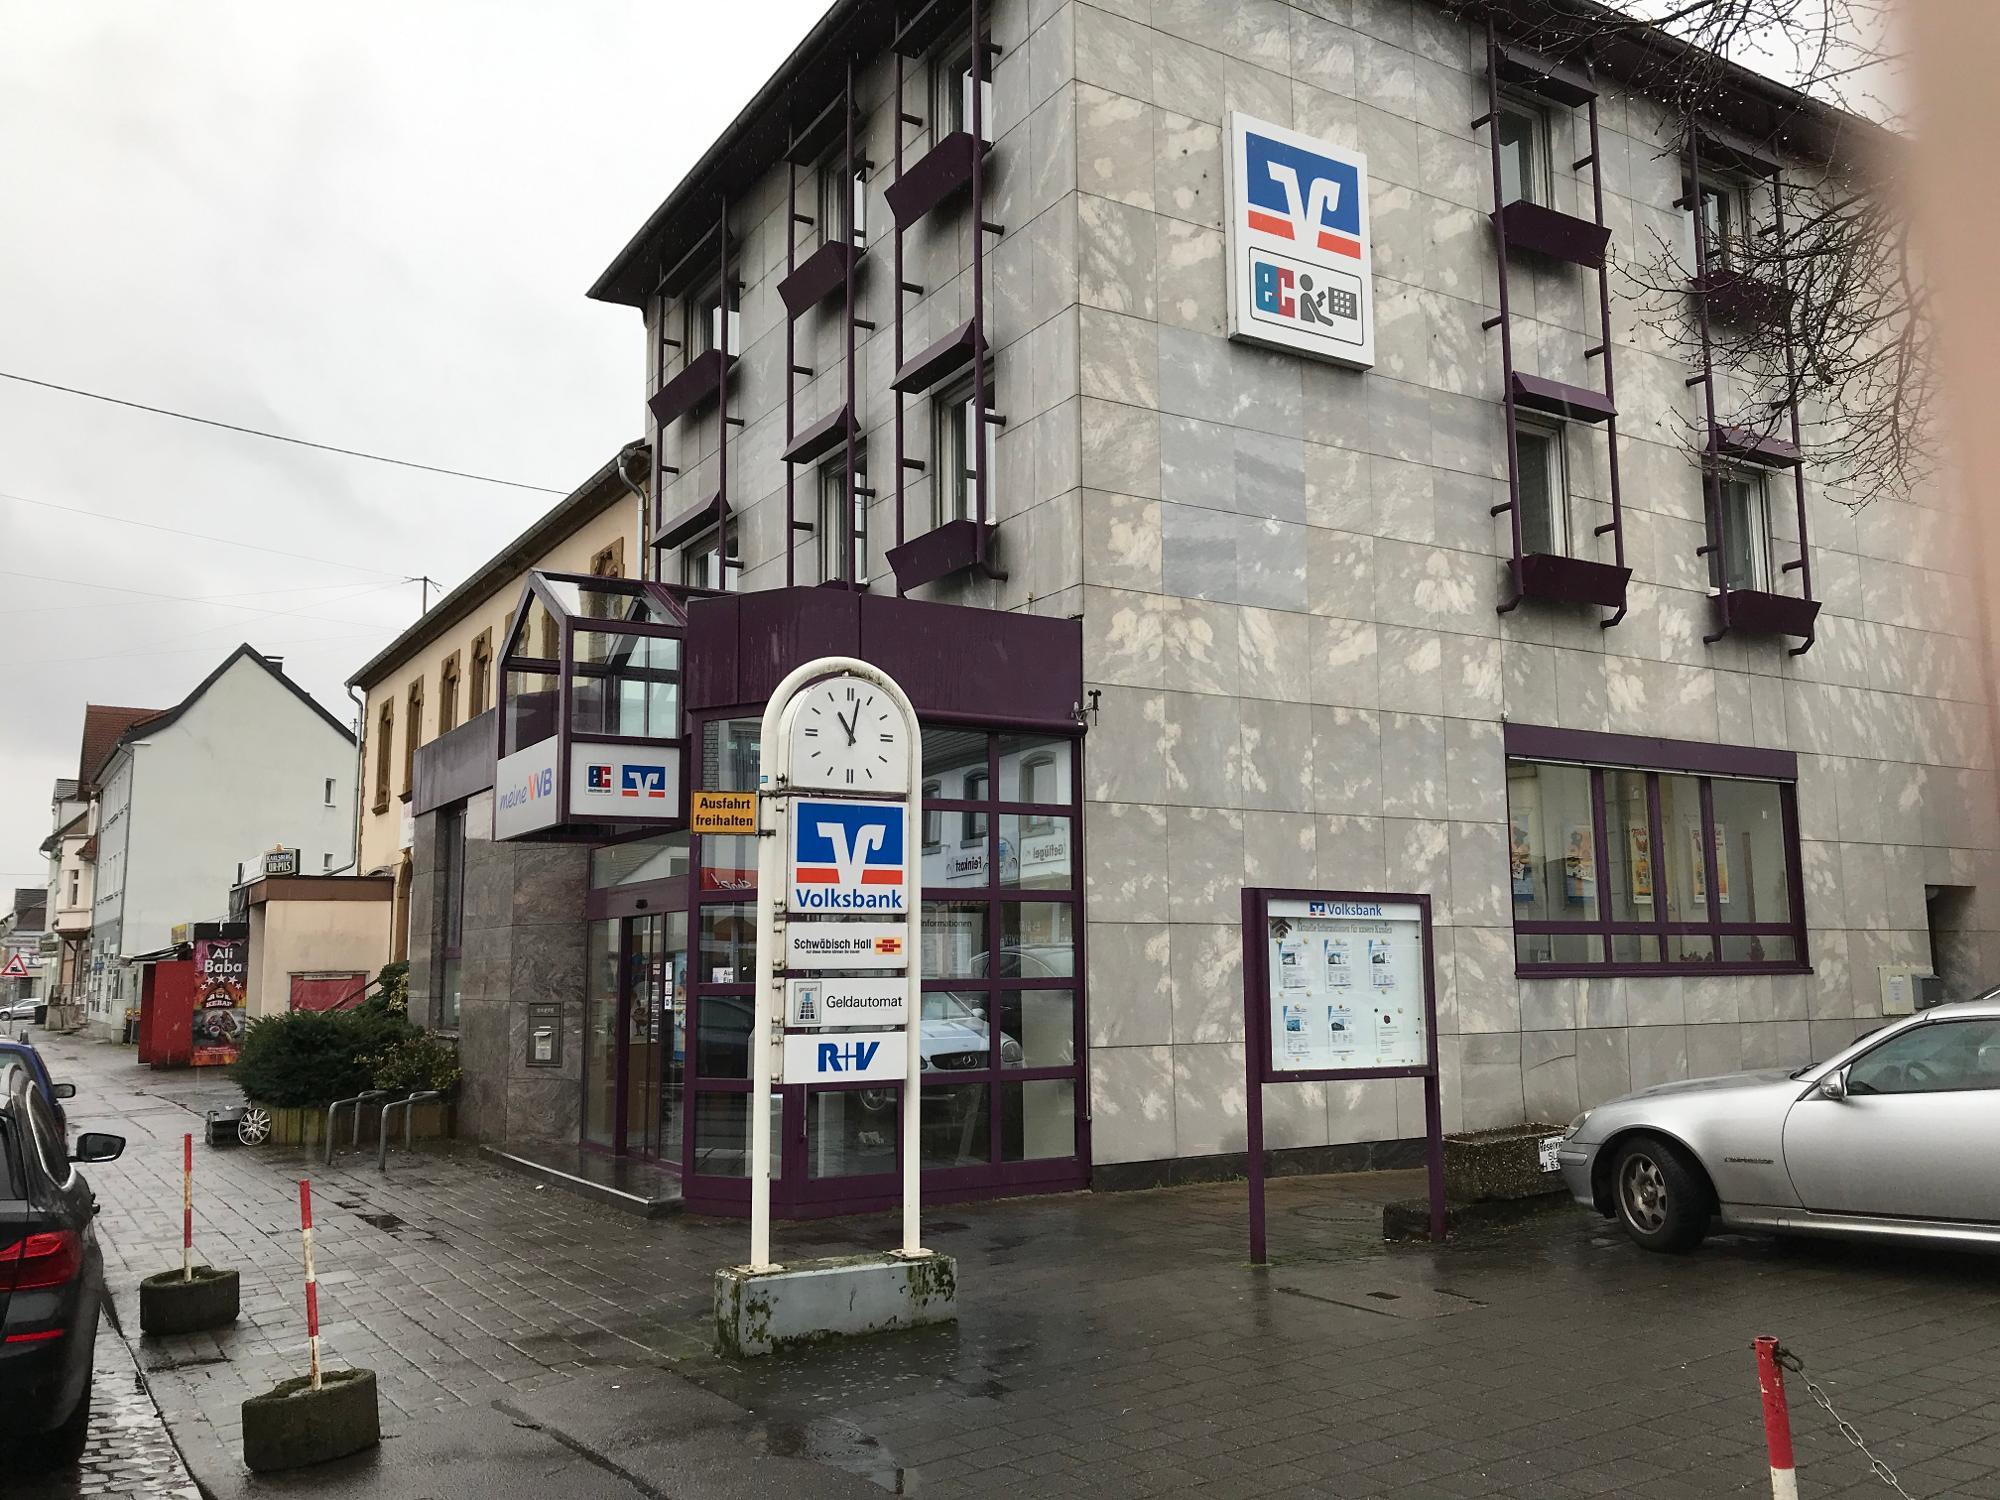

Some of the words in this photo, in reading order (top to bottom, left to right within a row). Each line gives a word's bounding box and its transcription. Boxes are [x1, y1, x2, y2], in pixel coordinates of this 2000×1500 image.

[500, 784, 527, 811] meine
[699, 797, 751, 810] Ausfahrt
[695, 813, 753, 826] freihalten
[796, 888, 903, 909] Volksbank
[1328, 903, 1382, 917] Volksbank
[794, 938, 851, 950] Schwäbisch
[853, 938, 872, 950] Hall
[212, 948, 233, 959] Ali
[204, 960, 242, 973] Baba
[826, 995, 903, 1008] Geldautomat
